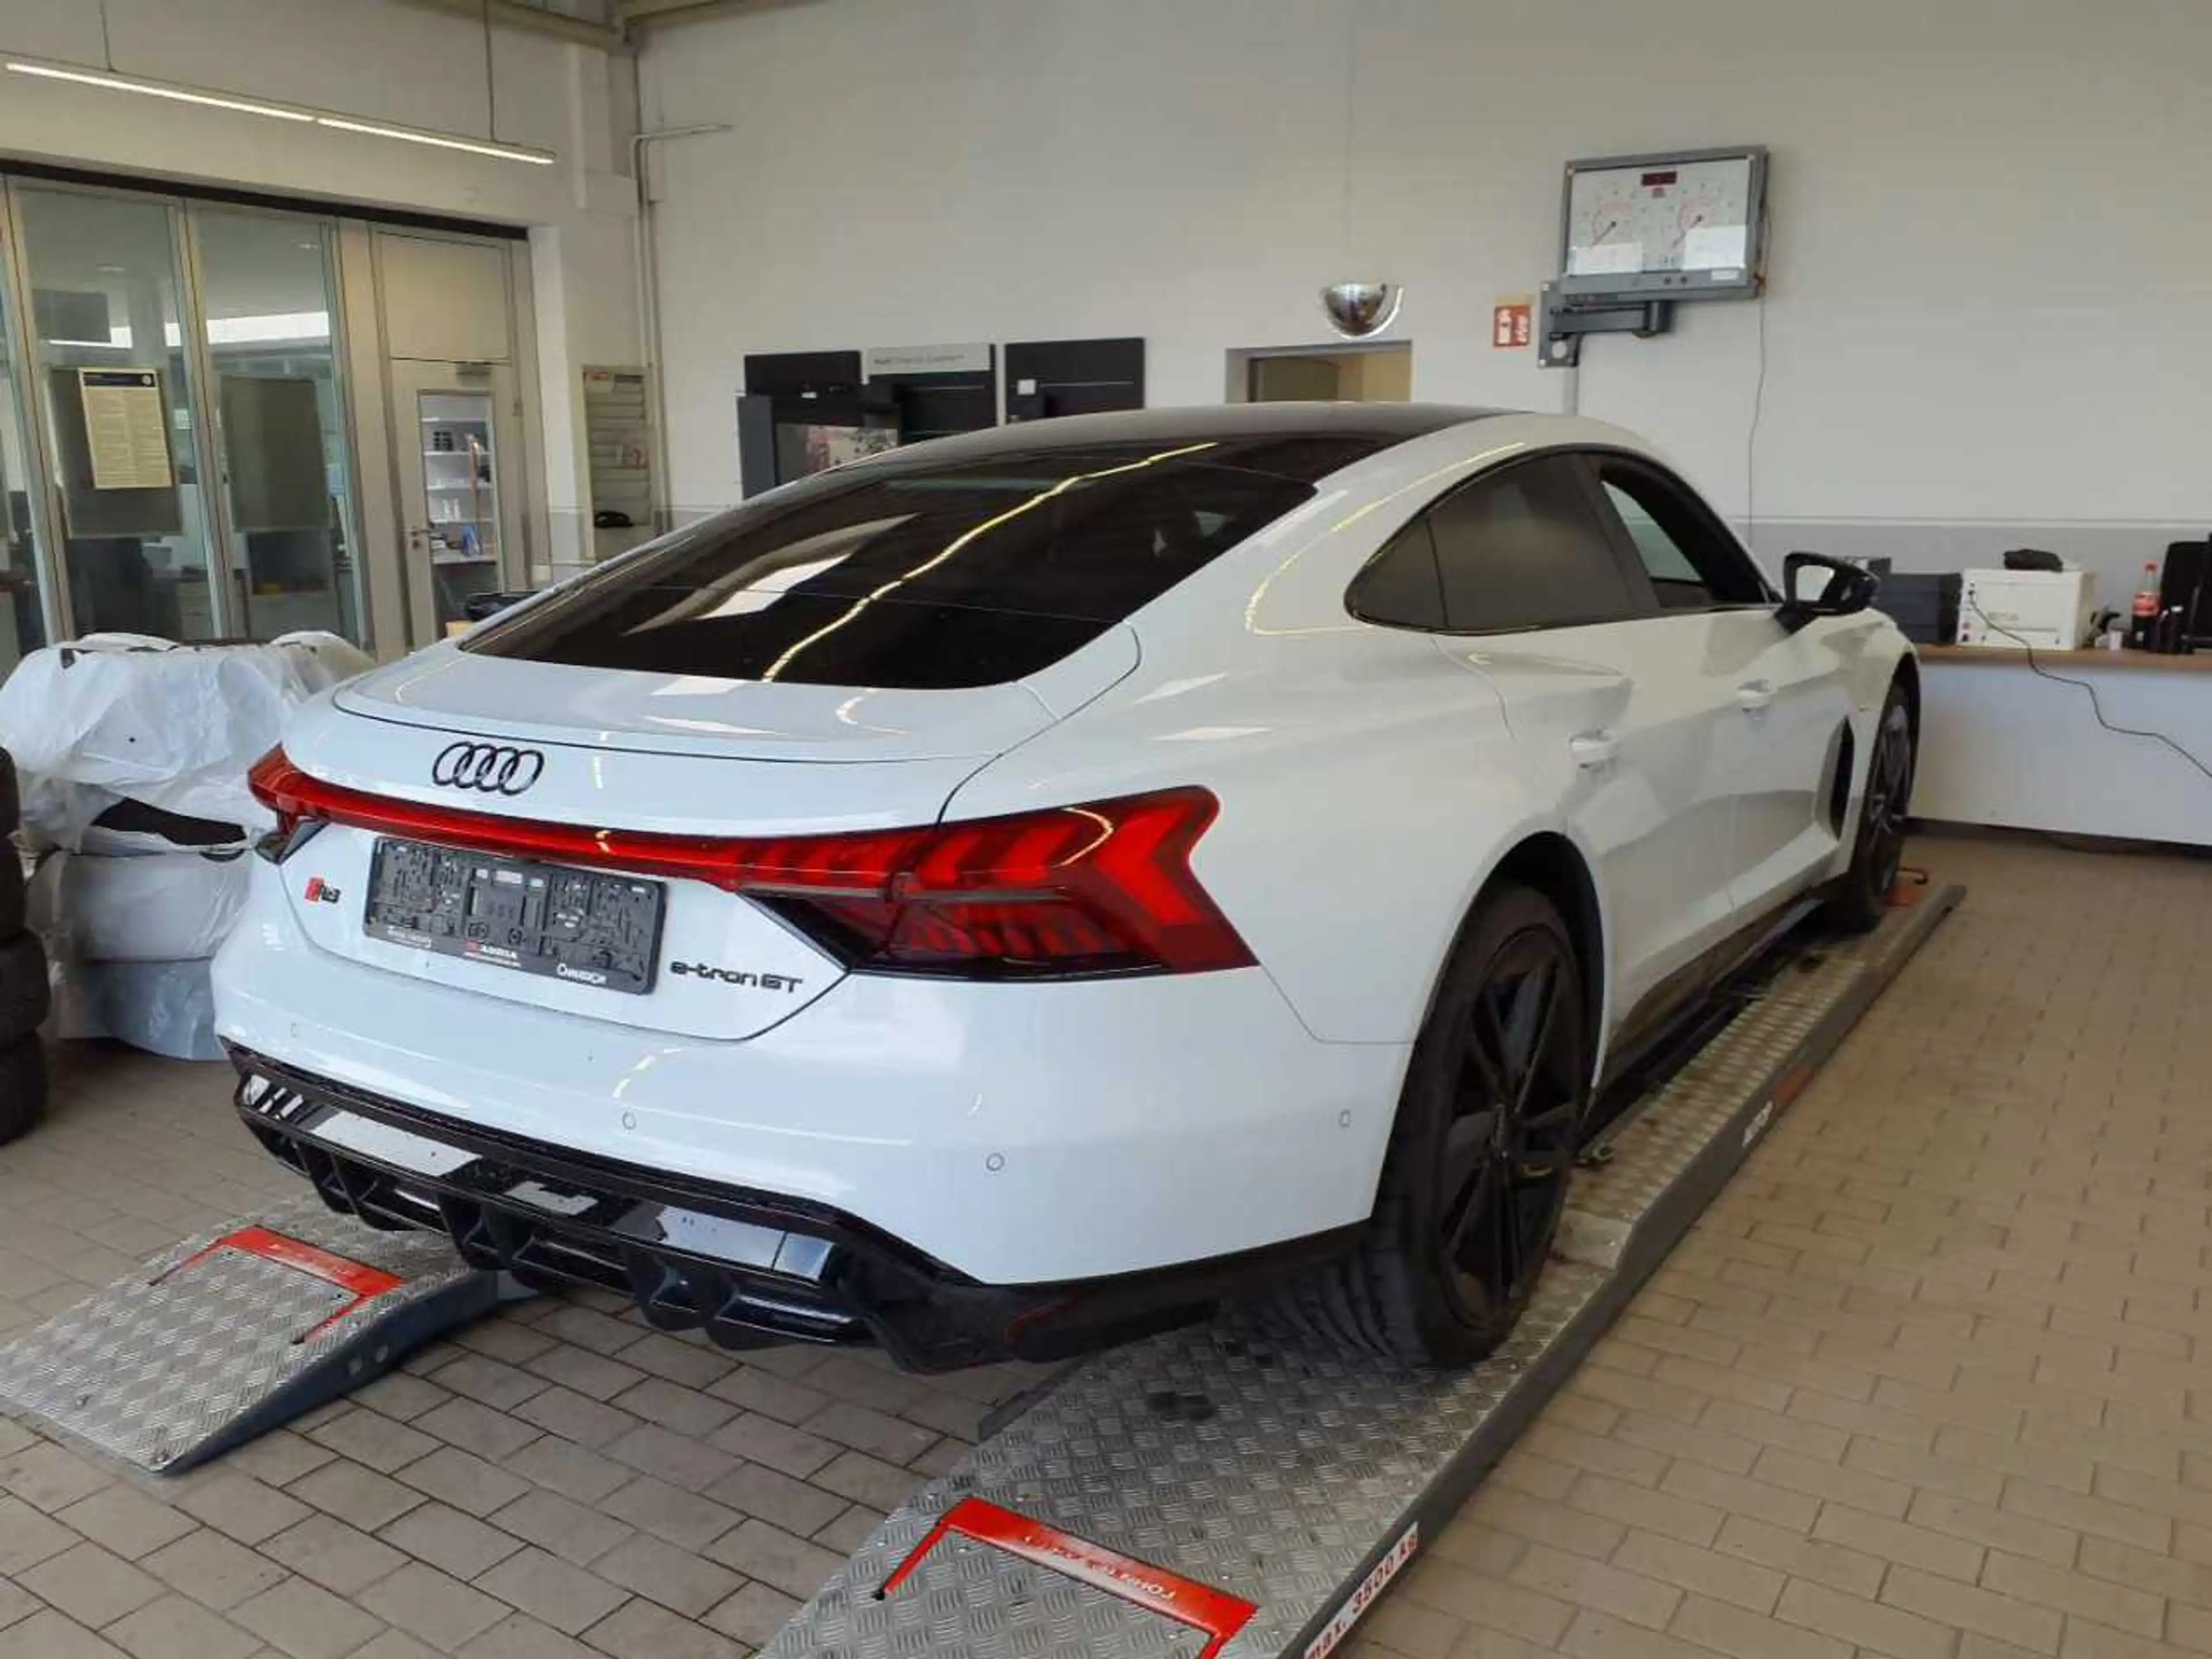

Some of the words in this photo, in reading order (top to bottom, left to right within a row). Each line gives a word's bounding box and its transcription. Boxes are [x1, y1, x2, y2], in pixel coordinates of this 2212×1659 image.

[670, 960, 757, 987] e-tron
[760, 973, 803, 994] GT
[1353, 1554, 1395, 1613] 3500
